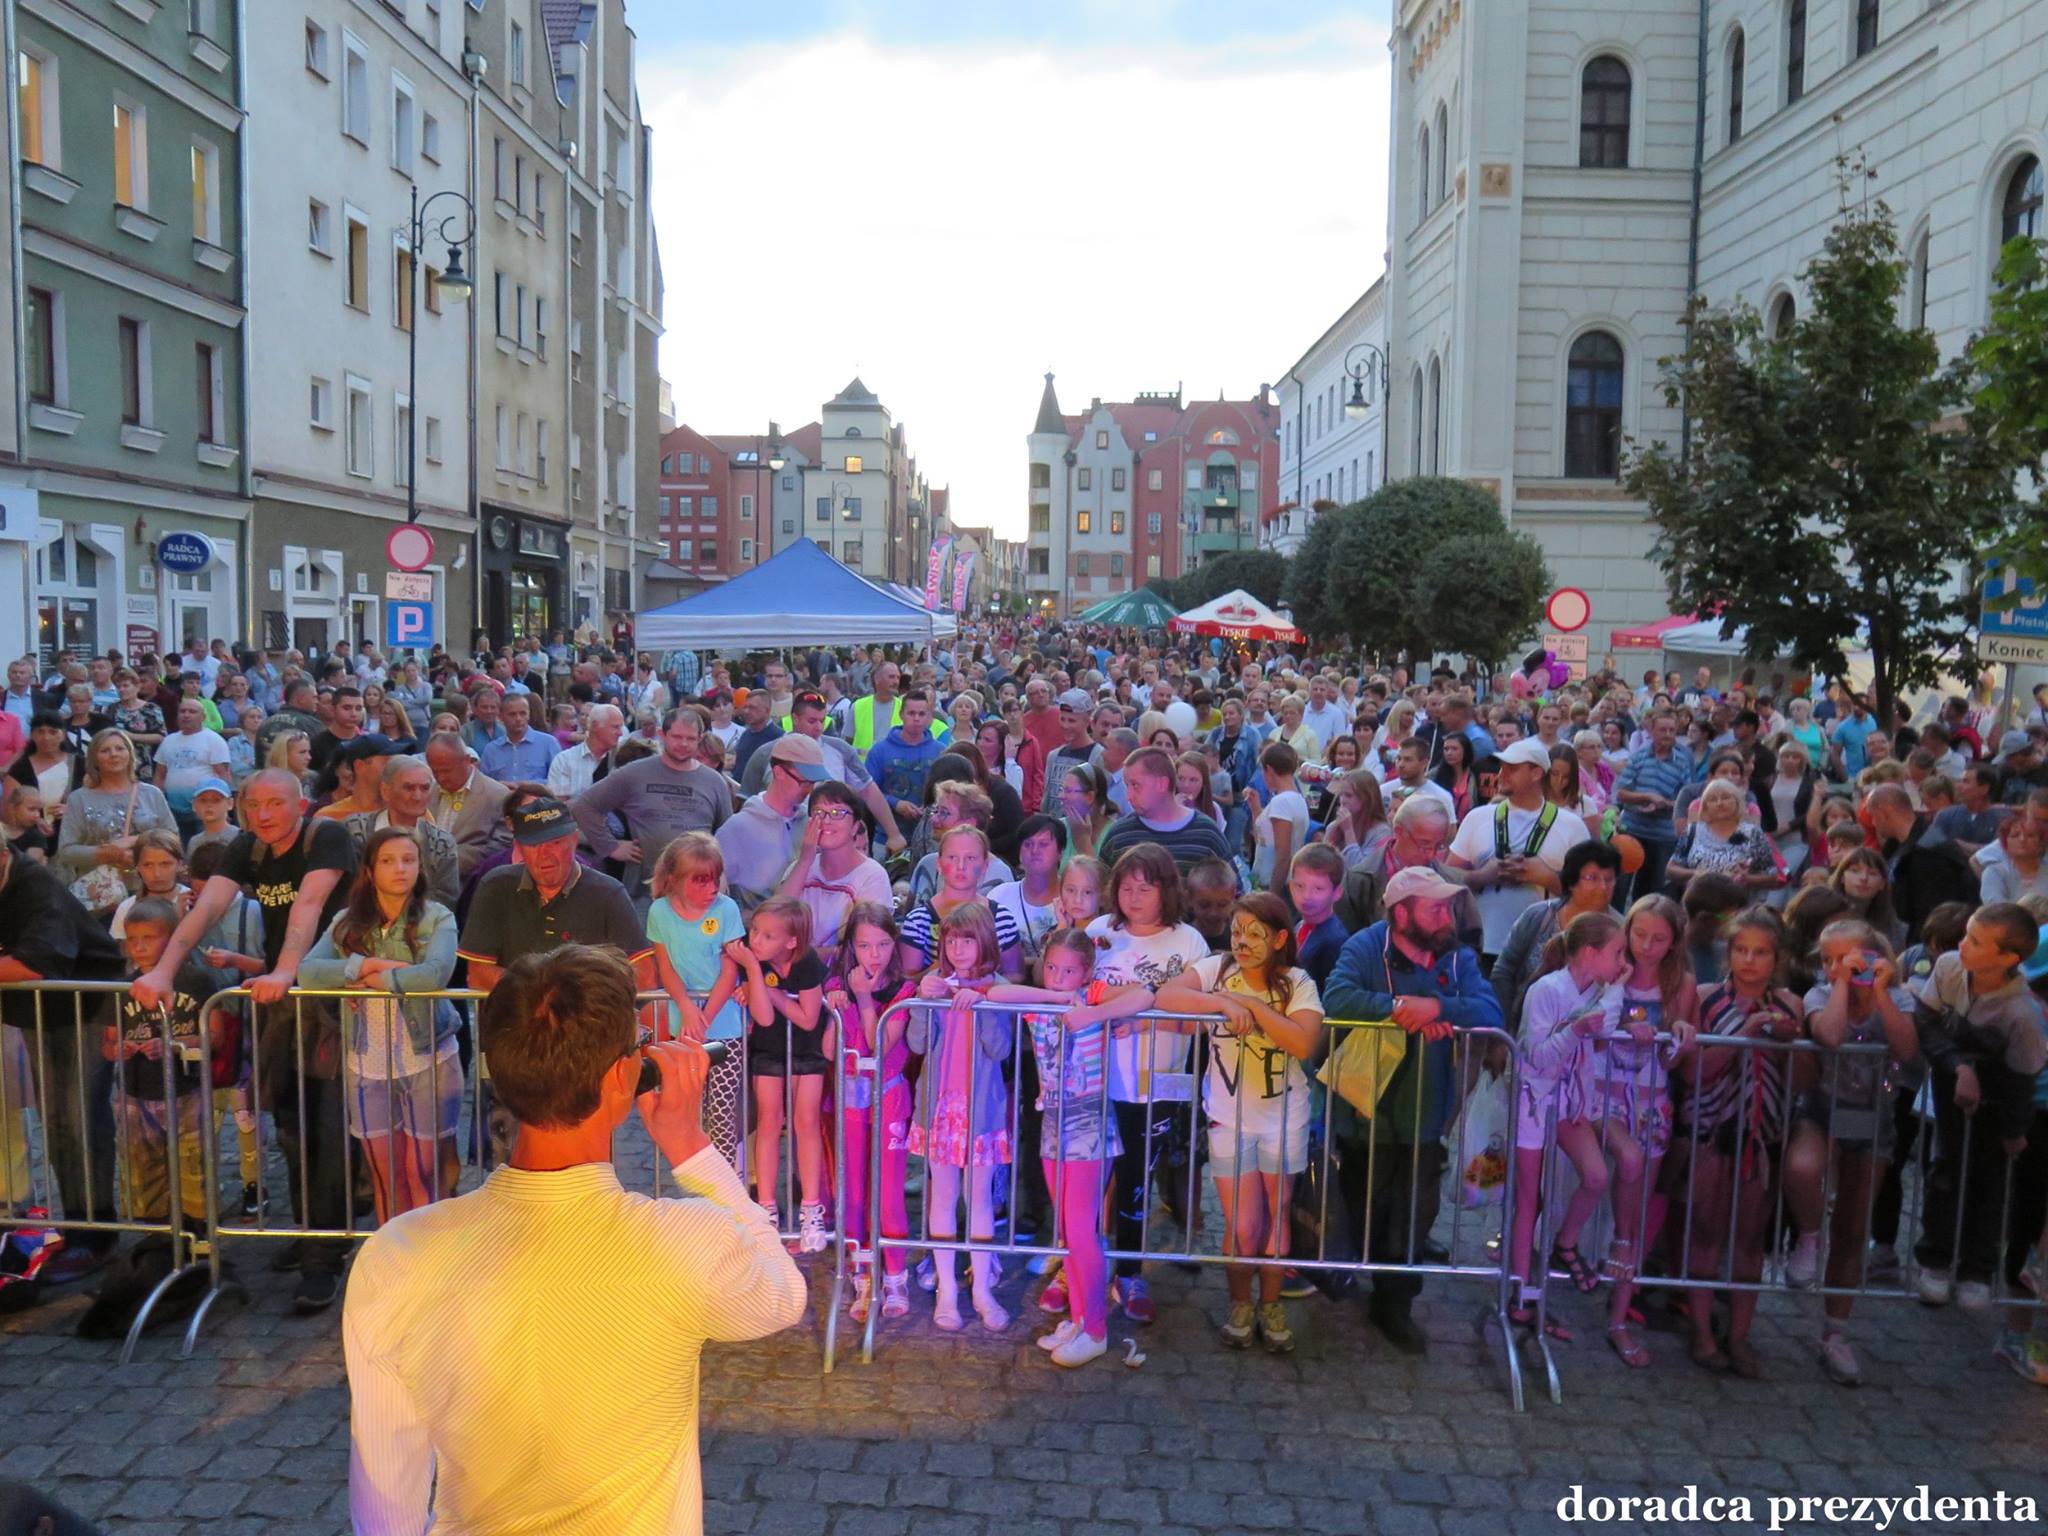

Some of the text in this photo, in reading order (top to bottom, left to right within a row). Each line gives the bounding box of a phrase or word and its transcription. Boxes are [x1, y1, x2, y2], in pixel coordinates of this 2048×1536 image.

[167, 543, 200, 554] RADCA
[163, 551, 203, 564] PRAWNY
[398, 606, 423, 642] P
[1176, 622, 1197, 633] TYSKIE
[1220, 625, 1250, 638] TYSKIE
[1274, 630, 1296, 642] TYSKIE
[1988, 640, 2045, 660] Koniec
